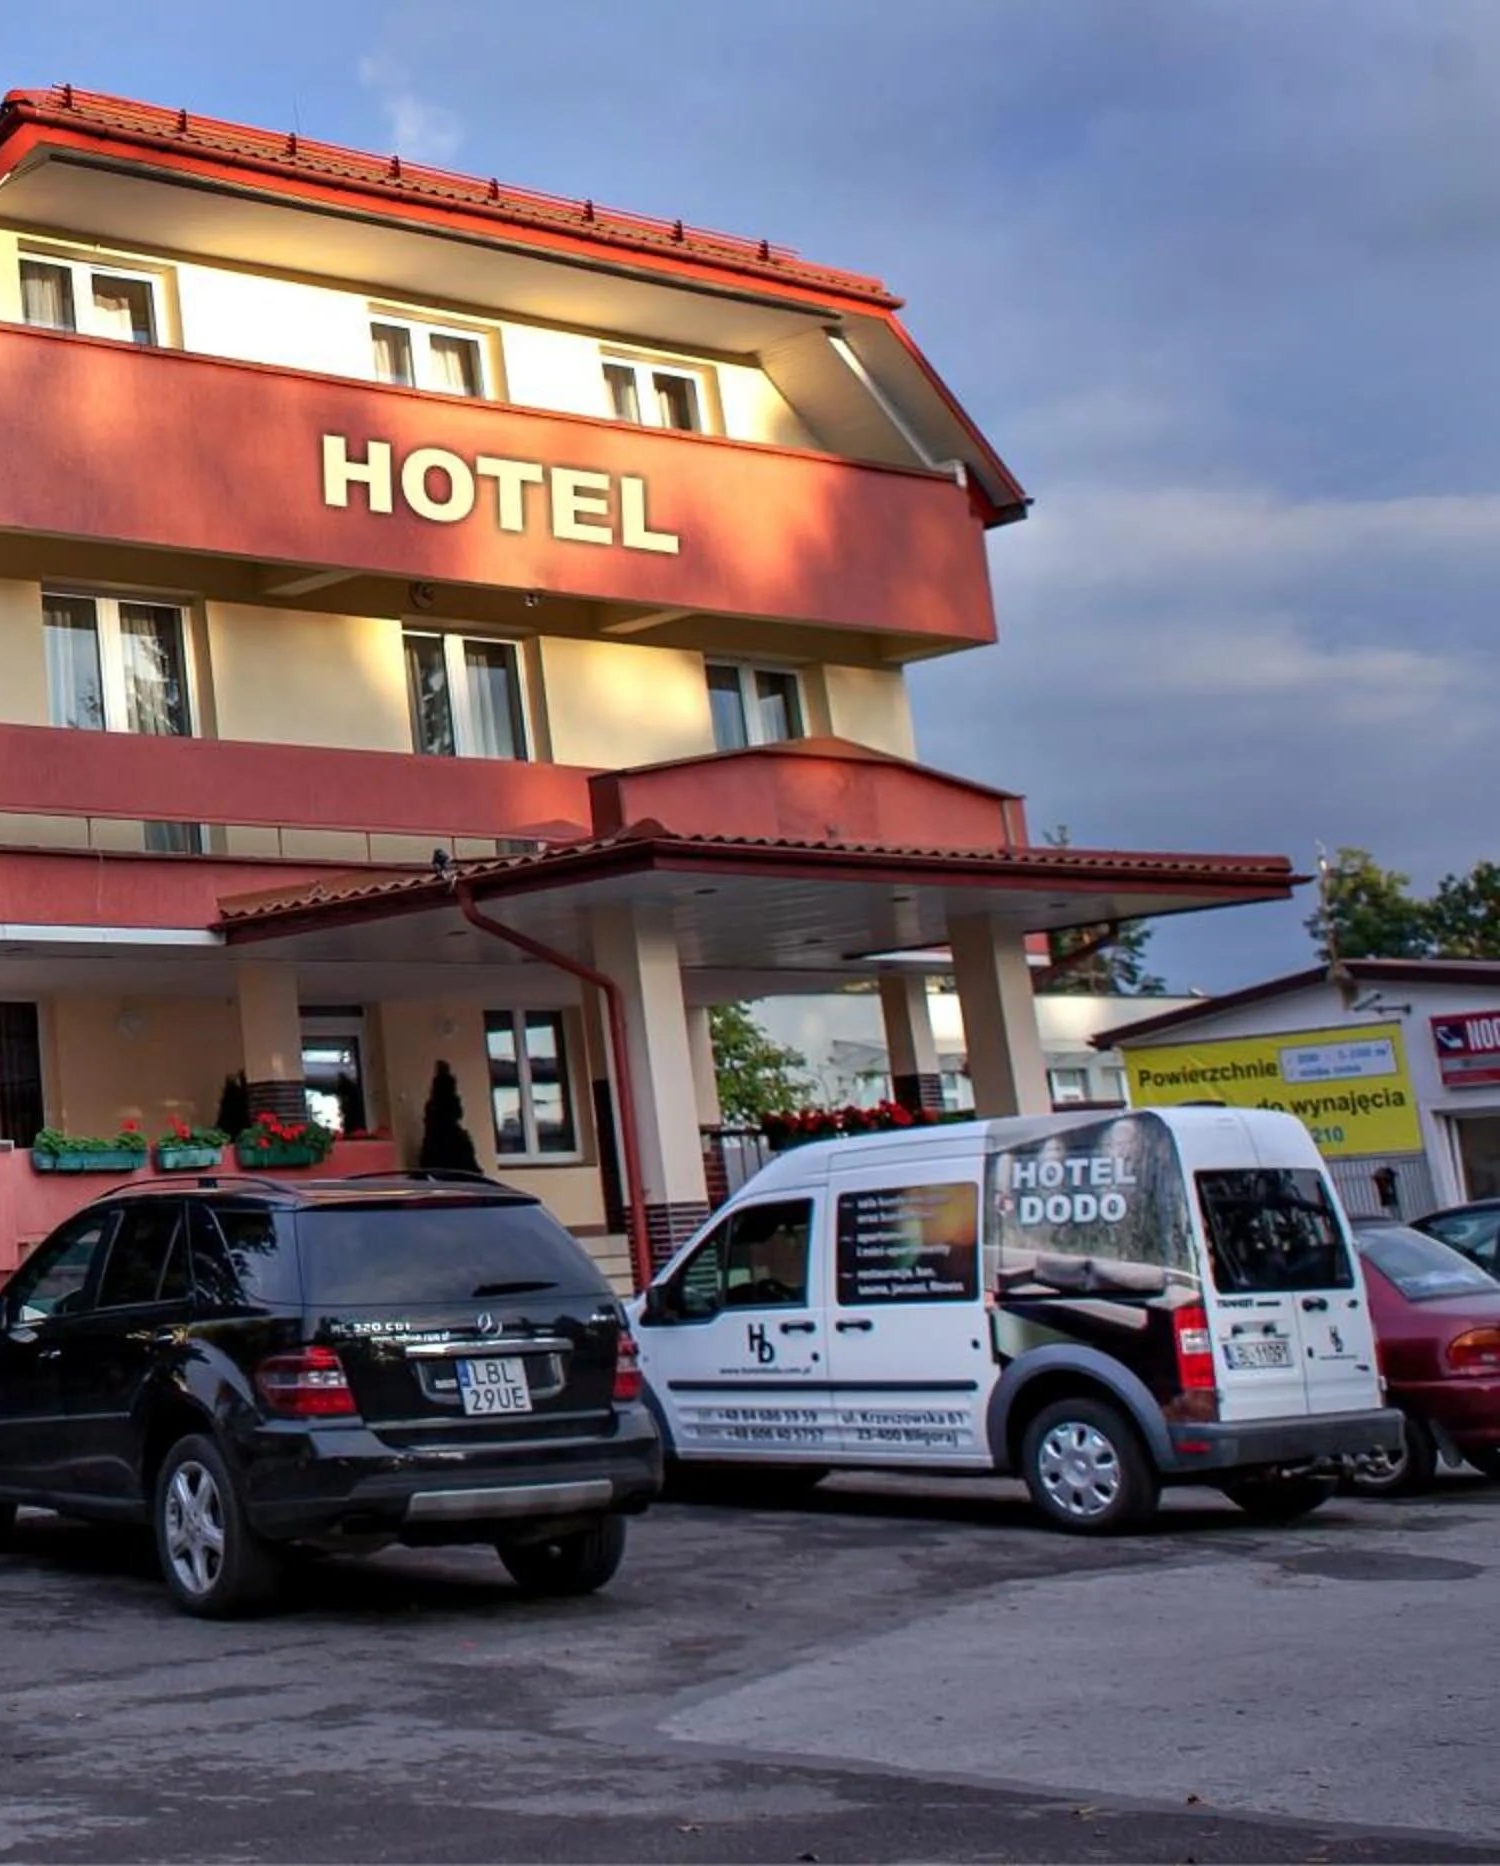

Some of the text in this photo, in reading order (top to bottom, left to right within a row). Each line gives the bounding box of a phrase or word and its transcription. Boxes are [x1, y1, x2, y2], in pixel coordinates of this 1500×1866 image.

[322, 434, 680, 554] HOTEL
[1138, 1058, 1279, 1088] Powierzchnie
[1290, 1087, 1406, 1119] wynajęcia
[1012, 1156, 1137, 1189] HOTEL
[1019, 1192, 1128, 1225] DODO
[473, 1361, 515, 1385] LBL
[471, 1386, 526, 1411] 29UE
